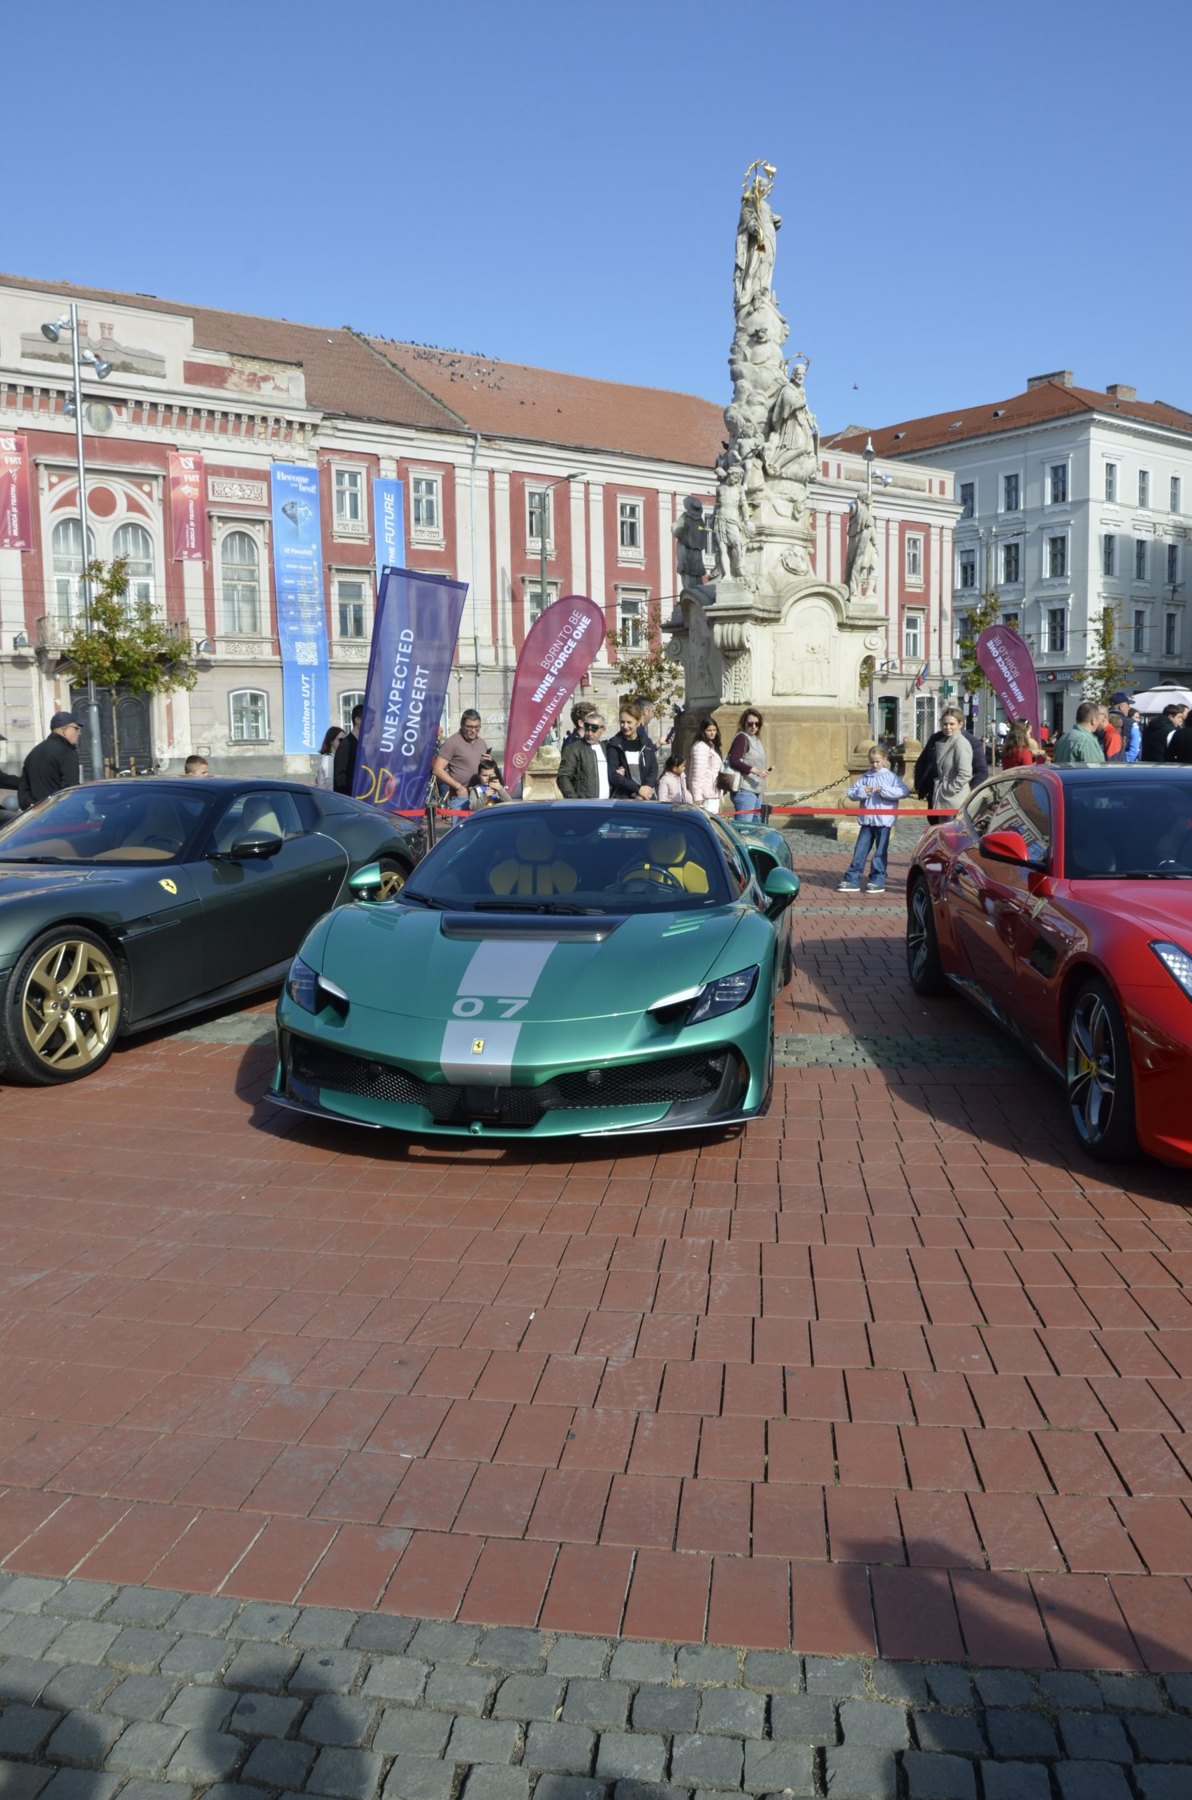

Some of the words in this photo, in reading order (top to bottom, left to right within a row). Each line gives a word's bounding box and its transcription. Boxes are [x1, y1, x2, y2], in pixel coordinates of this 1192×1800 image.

[384, 492, 396, 545] FUTURE
[531, 673, 556, 703] WINE
[550, 639, 577, 675] FORCE
[573, 615, 591, 640] ONE
[540, 640, 564, 670] BORN
[559, 624, 573, 640] TO
[569, 609, 583, 625] BE
[301, 673, 311, 698] UVT
[380, 629, 414, 752] UNEXPECTED
[401, 665, 429, 756] CONCERT
[302, 699, 311, 748] Admitere
[452, 998, 529, 1018] 07
